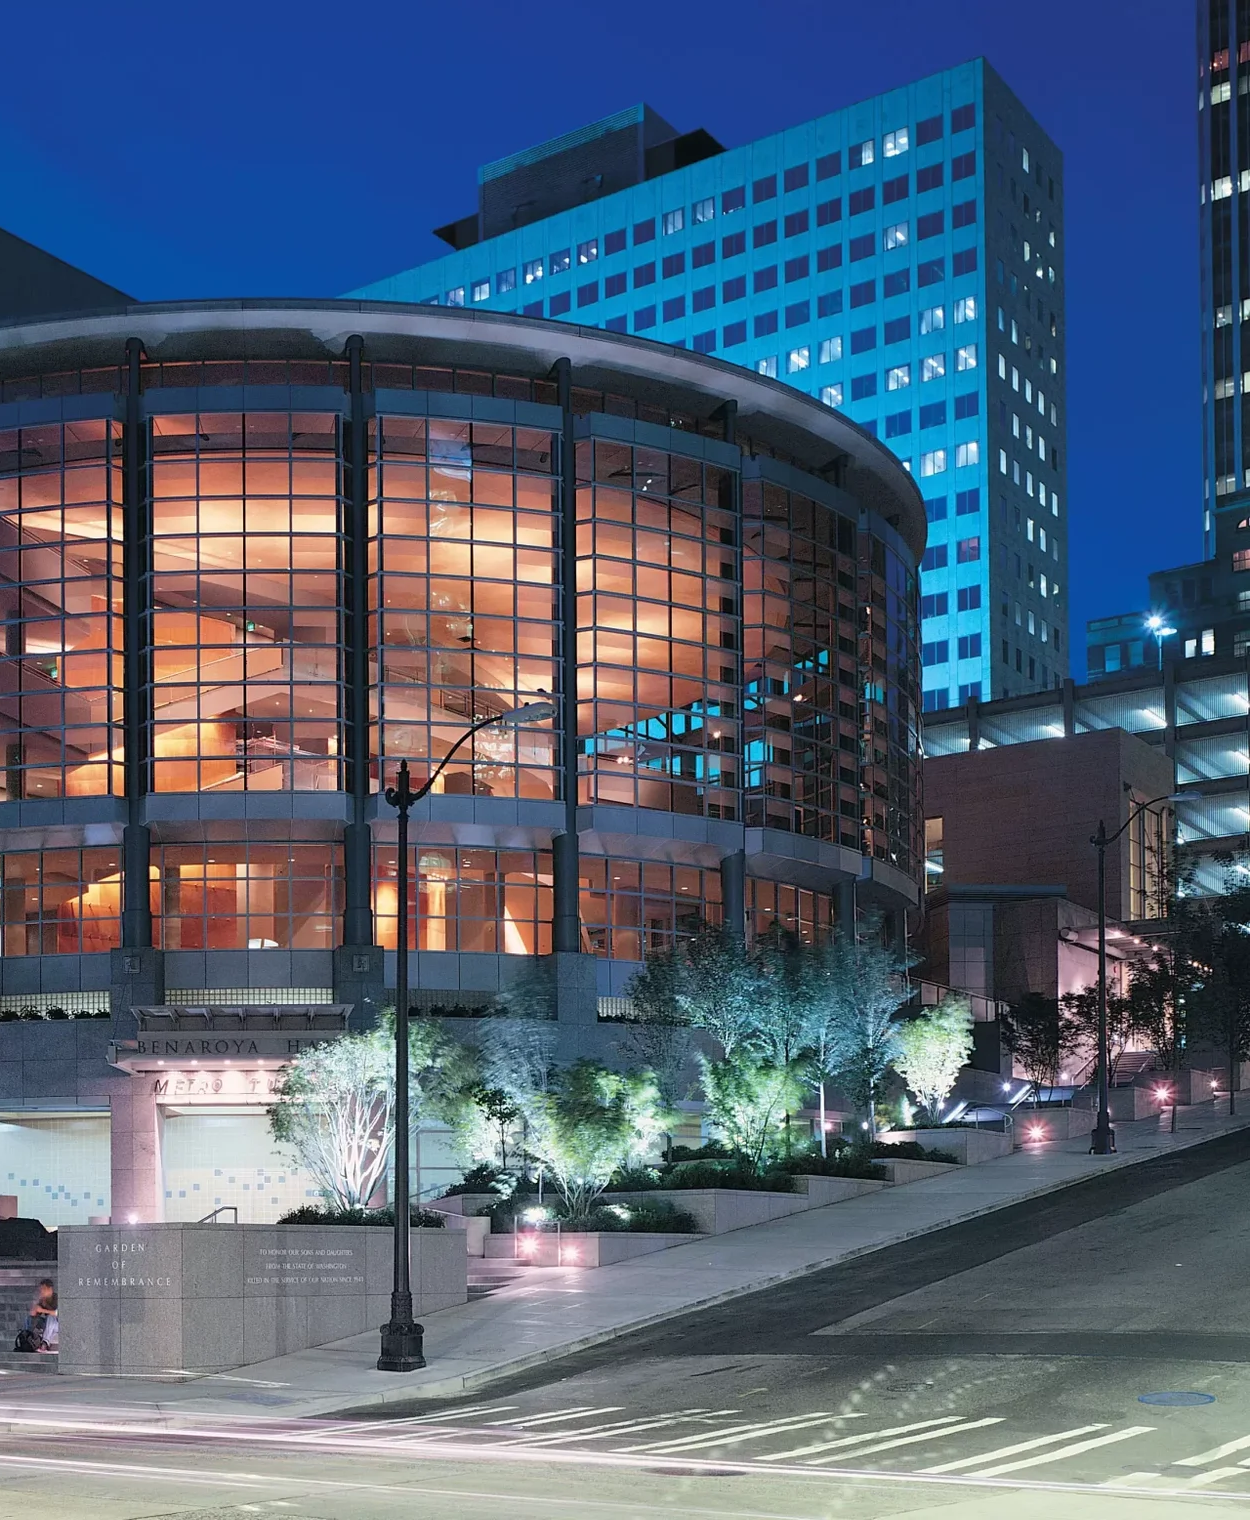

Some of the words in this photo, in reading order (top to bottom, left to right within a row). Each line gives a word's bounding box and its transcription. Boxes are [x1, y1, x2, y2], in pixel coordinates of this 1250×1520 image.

[137, 1040, 258, 1054] BENAROYA
[95, 1244, 145, 1253] GARDEN
[111, 1261, 126, 1269] OF
[78, 1277, 171, 1286] REMEMBRANCE
